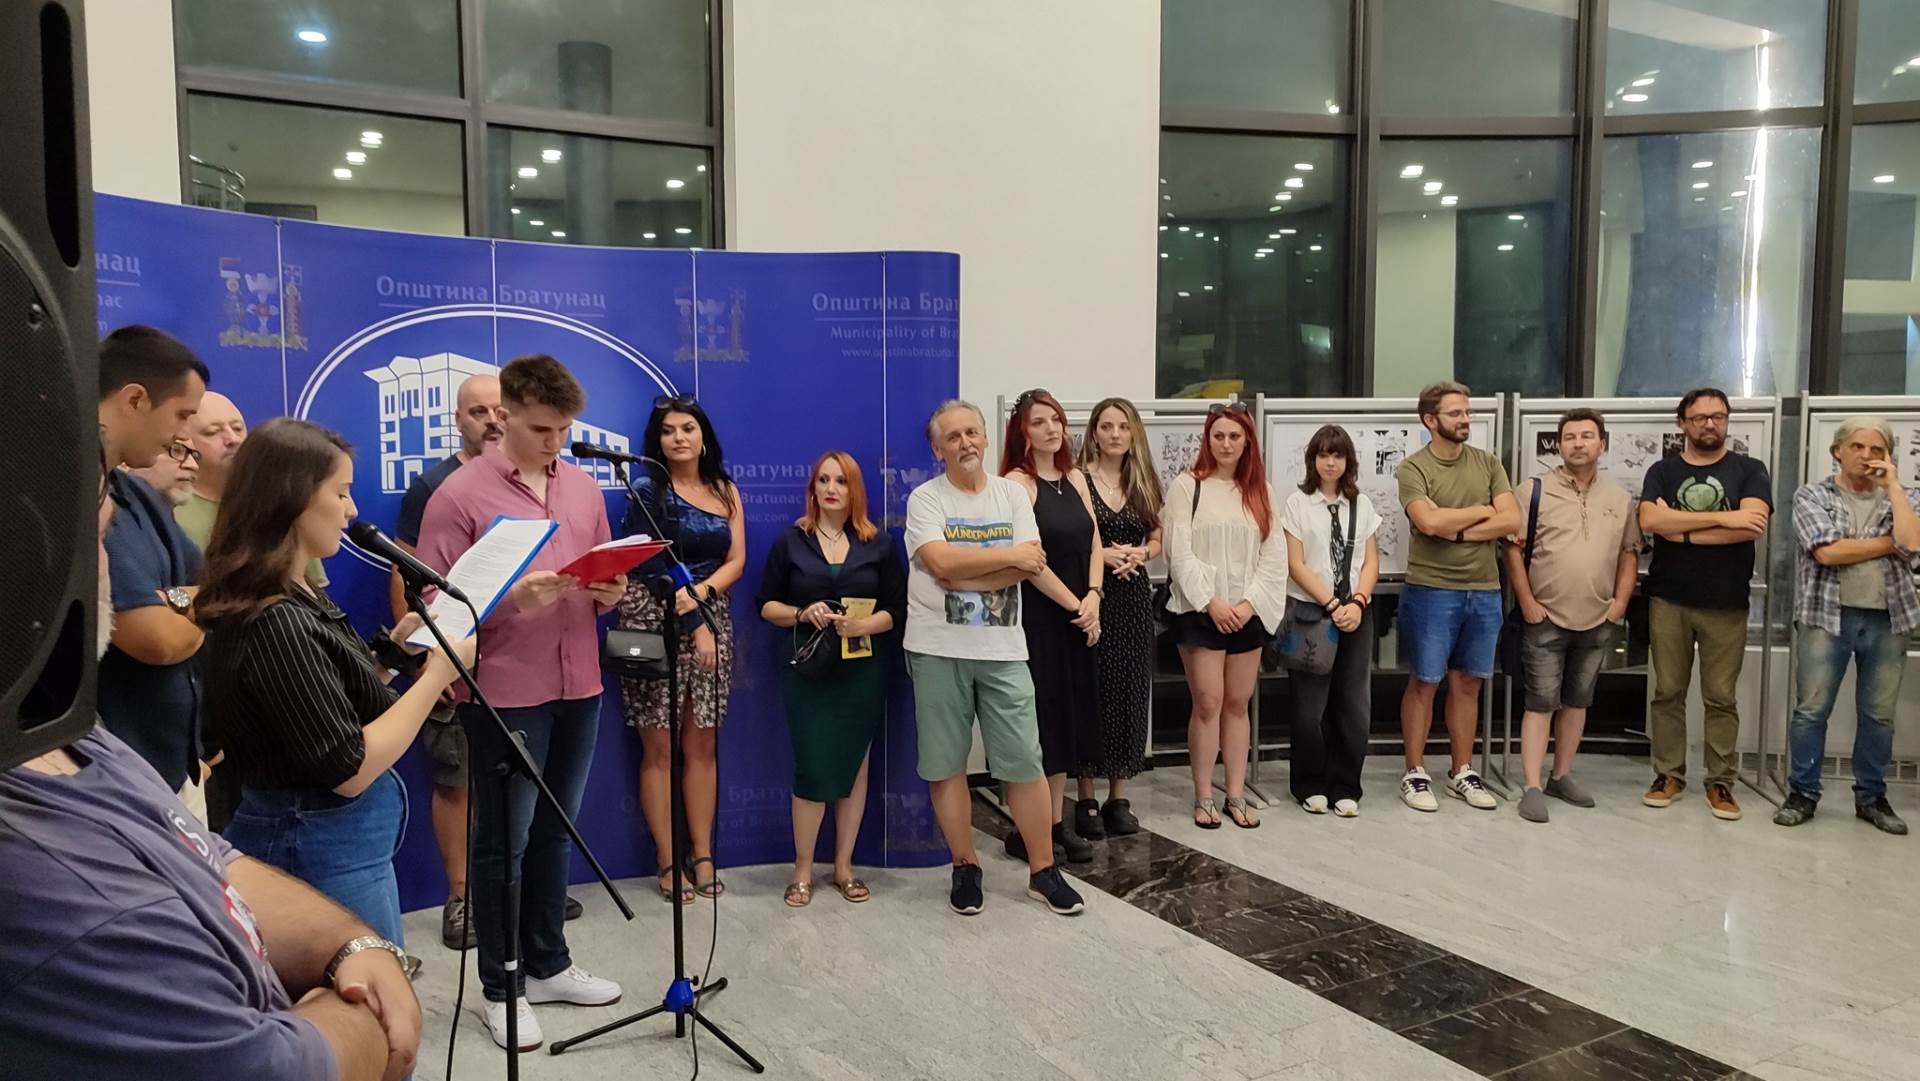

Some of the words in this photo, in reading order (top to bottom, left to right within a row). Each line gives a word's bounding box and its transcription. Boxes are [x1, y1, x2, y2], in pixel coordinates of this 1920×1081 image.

[376, 275, 488, 301] Општина
[499, 284, 606, 310] Братунац
[812, 292, 910, 312] Општина
[830, 326, 917, 341] Municipality
[921, 326, 935, 339] of
